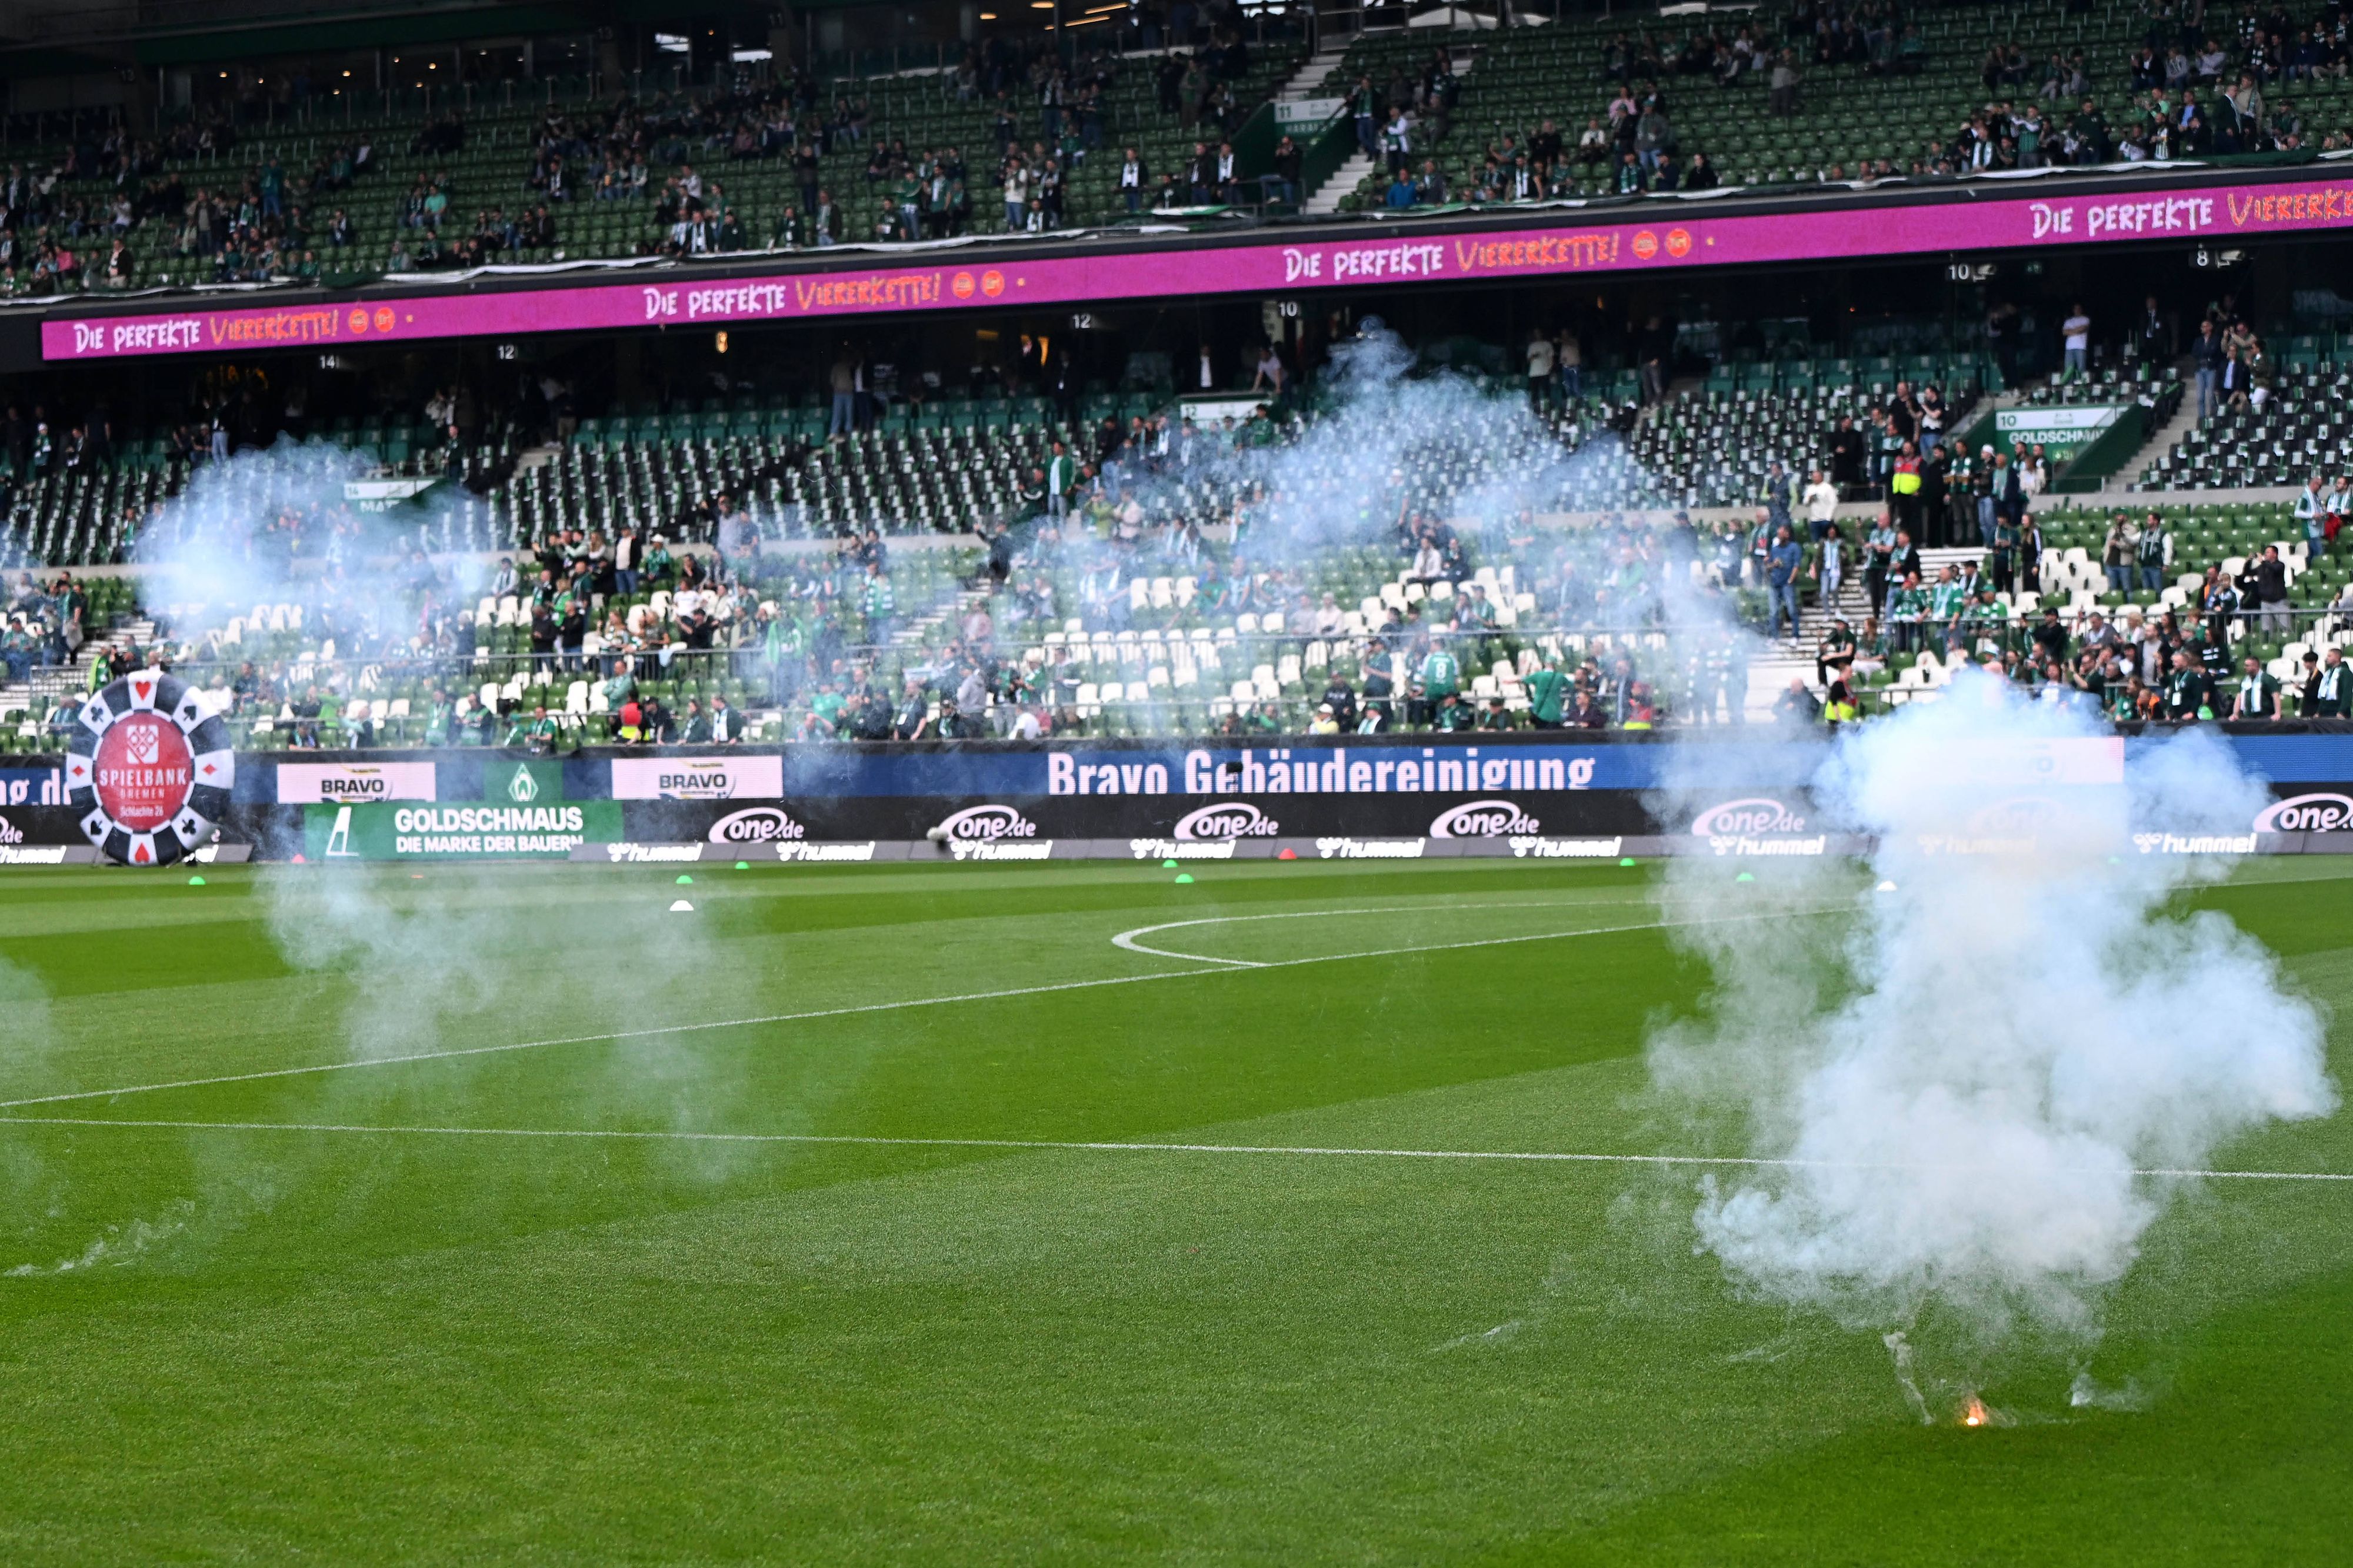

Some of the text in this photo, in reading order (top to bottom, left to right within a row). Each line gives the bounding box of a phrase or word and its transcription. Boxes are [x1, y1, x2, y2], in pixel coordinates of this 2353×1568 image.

[1279, 106, 1291, 118] 11
[2197, 249, 2207, 266] 8
[1949, 263, 1969, 279] 10
[1279, 302, 1297, 317] 10
[1073, 313, 1089, 328] 12
[498, 345, 514, 359] 12
[320, 355, 335, 369] 14
[2000, 415, 2017, 427] 10
[1435, 662, 1447, 679] 8
[99, 769, 186, 786] SPIELBANK
[321, 779, 384, 793] BRAVO
[659, 773, 726, 789] BRAVO
[395, 808, 584, 832] GOLDSCHMAUS
[396, 835, 584, 852] DIE MARKE DER BAUERN
[796, 841, 875, 861] hummel
[972, 840, 1053, 860] hummel
[1153, 839, 1236, 859] hummel
[1341, 838, 1425, 858] hummel
[1534, 836, 1621, 857] hummel
[1735, 835, 1825, 855] hummel
[2162, 832, 2257, 853] hummel
[628, 843, 704, 861] hummel
